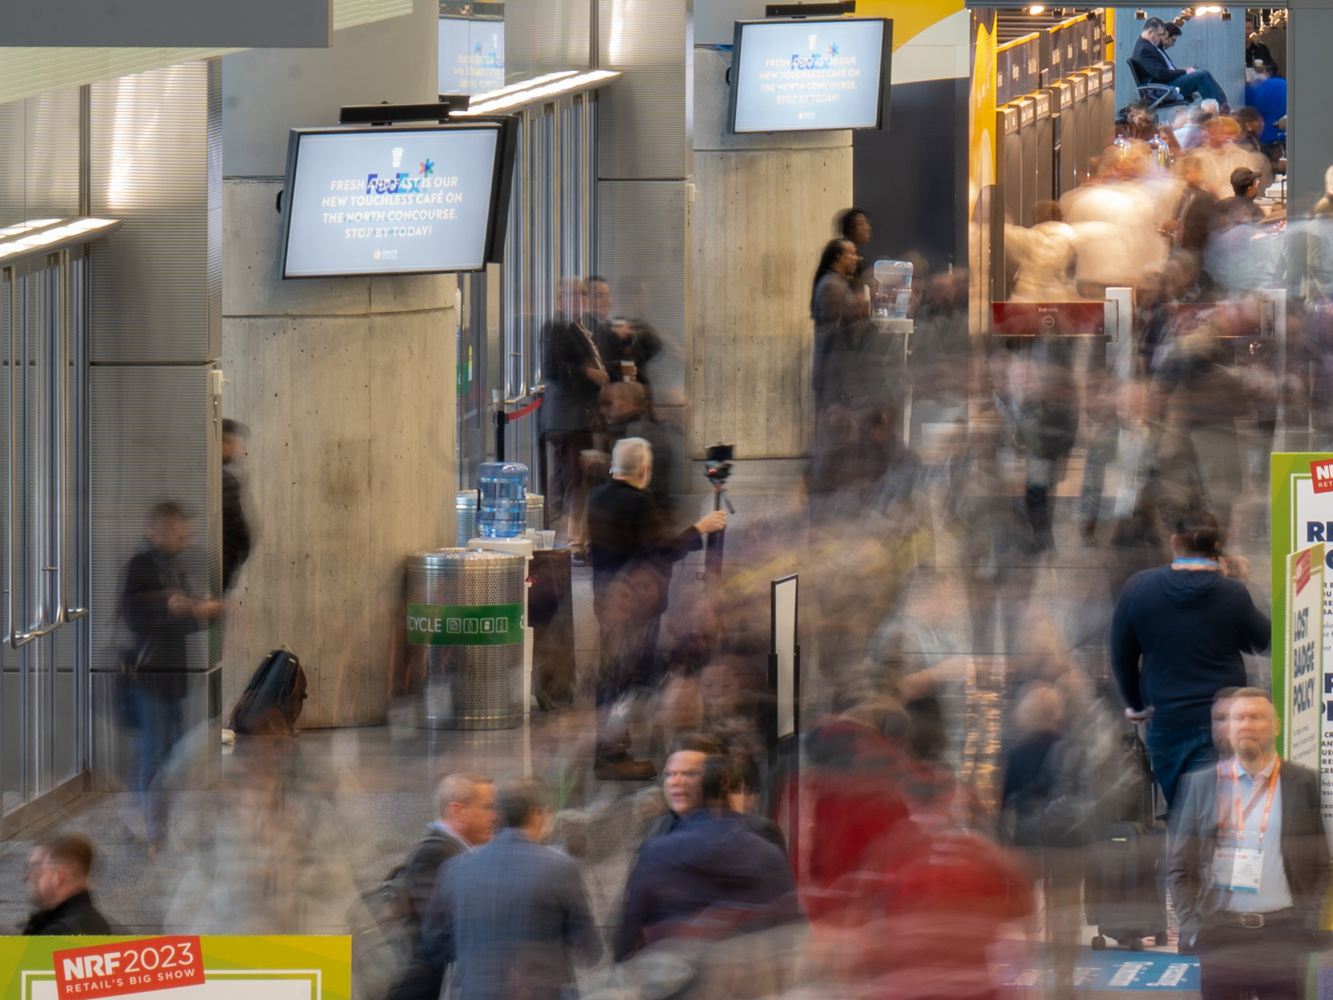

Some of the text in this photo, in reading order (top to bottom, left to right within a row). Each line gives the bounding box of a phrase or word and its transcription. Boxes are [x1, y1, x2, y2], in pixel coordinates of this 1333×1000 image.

[330, 179, 364, 191] FRESH
[421, 177, 431, 188] IS
[433, 176, 458, 187] OUR
[321, 190, 462, 207] NEW TOUCHLESS CAFÉ ON
[323, 208, 458, 224] THE NORTH CONCOURSE.
[344, 226, 432, 239] STOP BY TODAY!
[1294, 640, 1315, 679] BADGE
[1293, 677, 1315, 716] POLICY
[66, 968, 195, 993] RETAIL'S BIG SHOW
